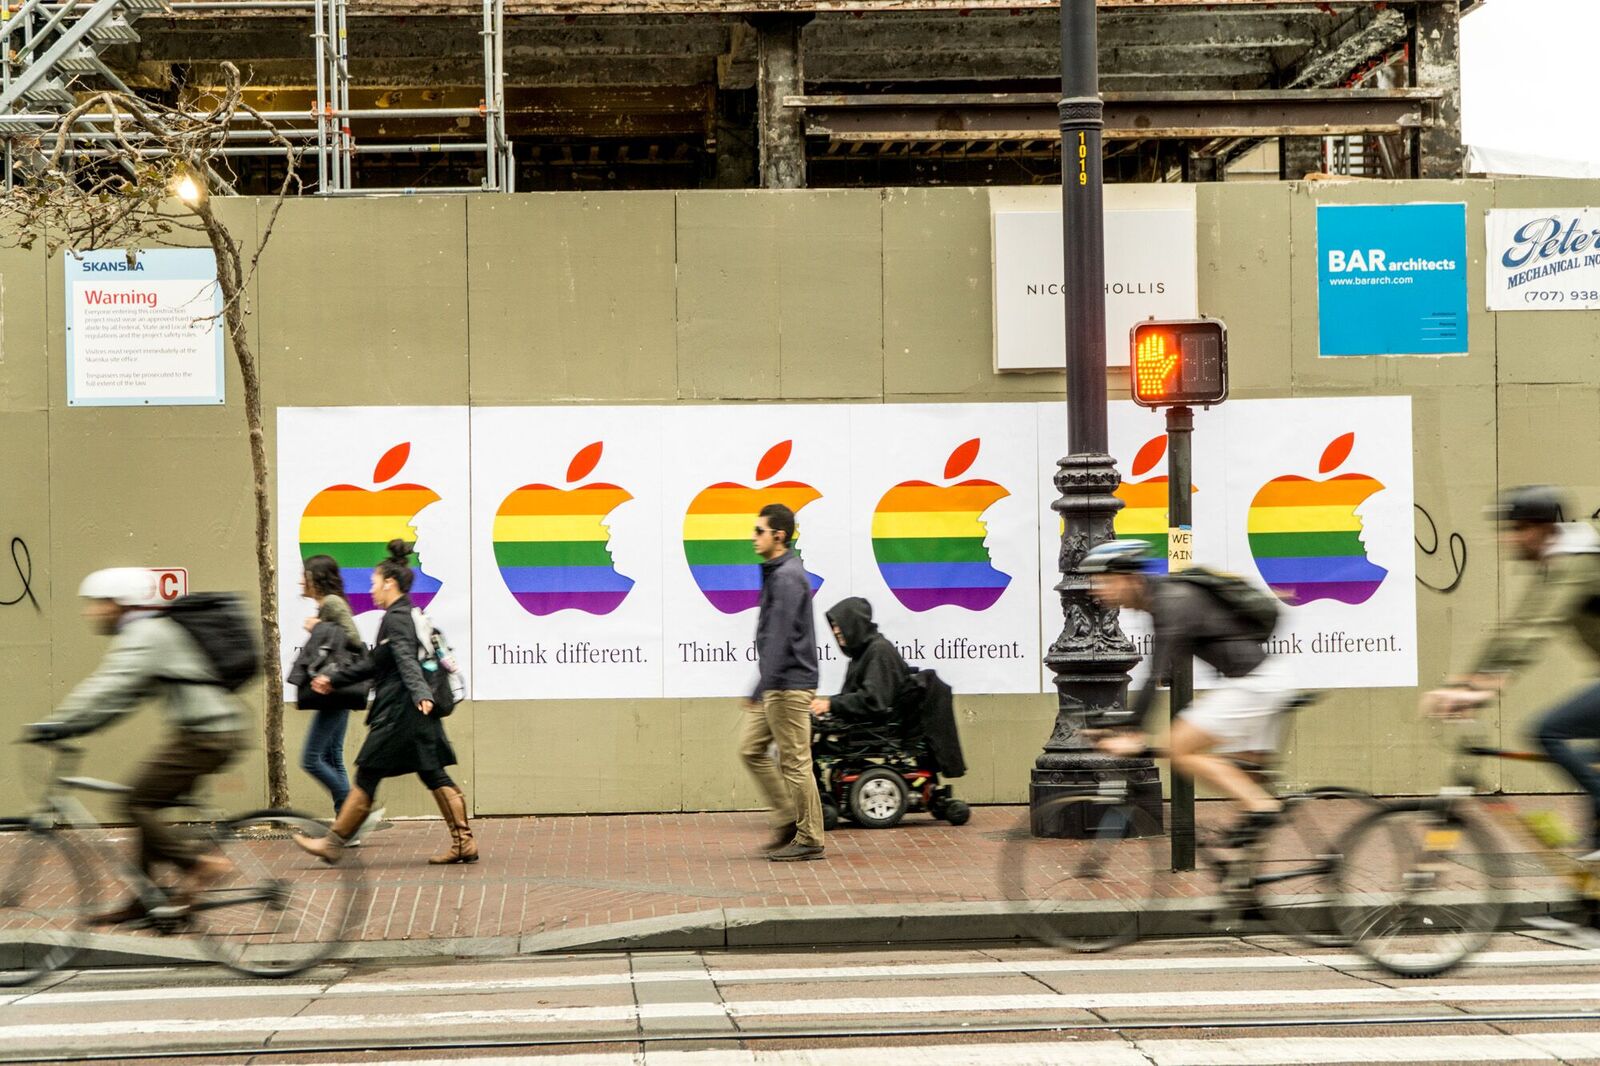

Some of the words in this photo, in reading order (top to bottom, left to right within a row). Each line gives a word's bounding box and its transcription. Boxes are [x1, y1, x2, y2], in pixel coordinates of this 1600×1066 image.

[1078, 131, 1087, 186] 1019
[1328, 249, 1387, 273] BAR
[1388, 257, 1456, 272] architects
[1329, 276, 1413, 286] www.bararch.com
[1507, 258, 1580, 290] MECHANICAL
[84, 290, 158, 308] Warning
[1524, 291, 1564, 303] (707)
[488, 643, 548, 665] Think
[556, 642, 648, 664] different.
[679, 641, 738, 663] Think
[895, 638, 926, 660] ink
[934, 638, 1025, 660] different.
[1311, 632, 1402, 653] different.
